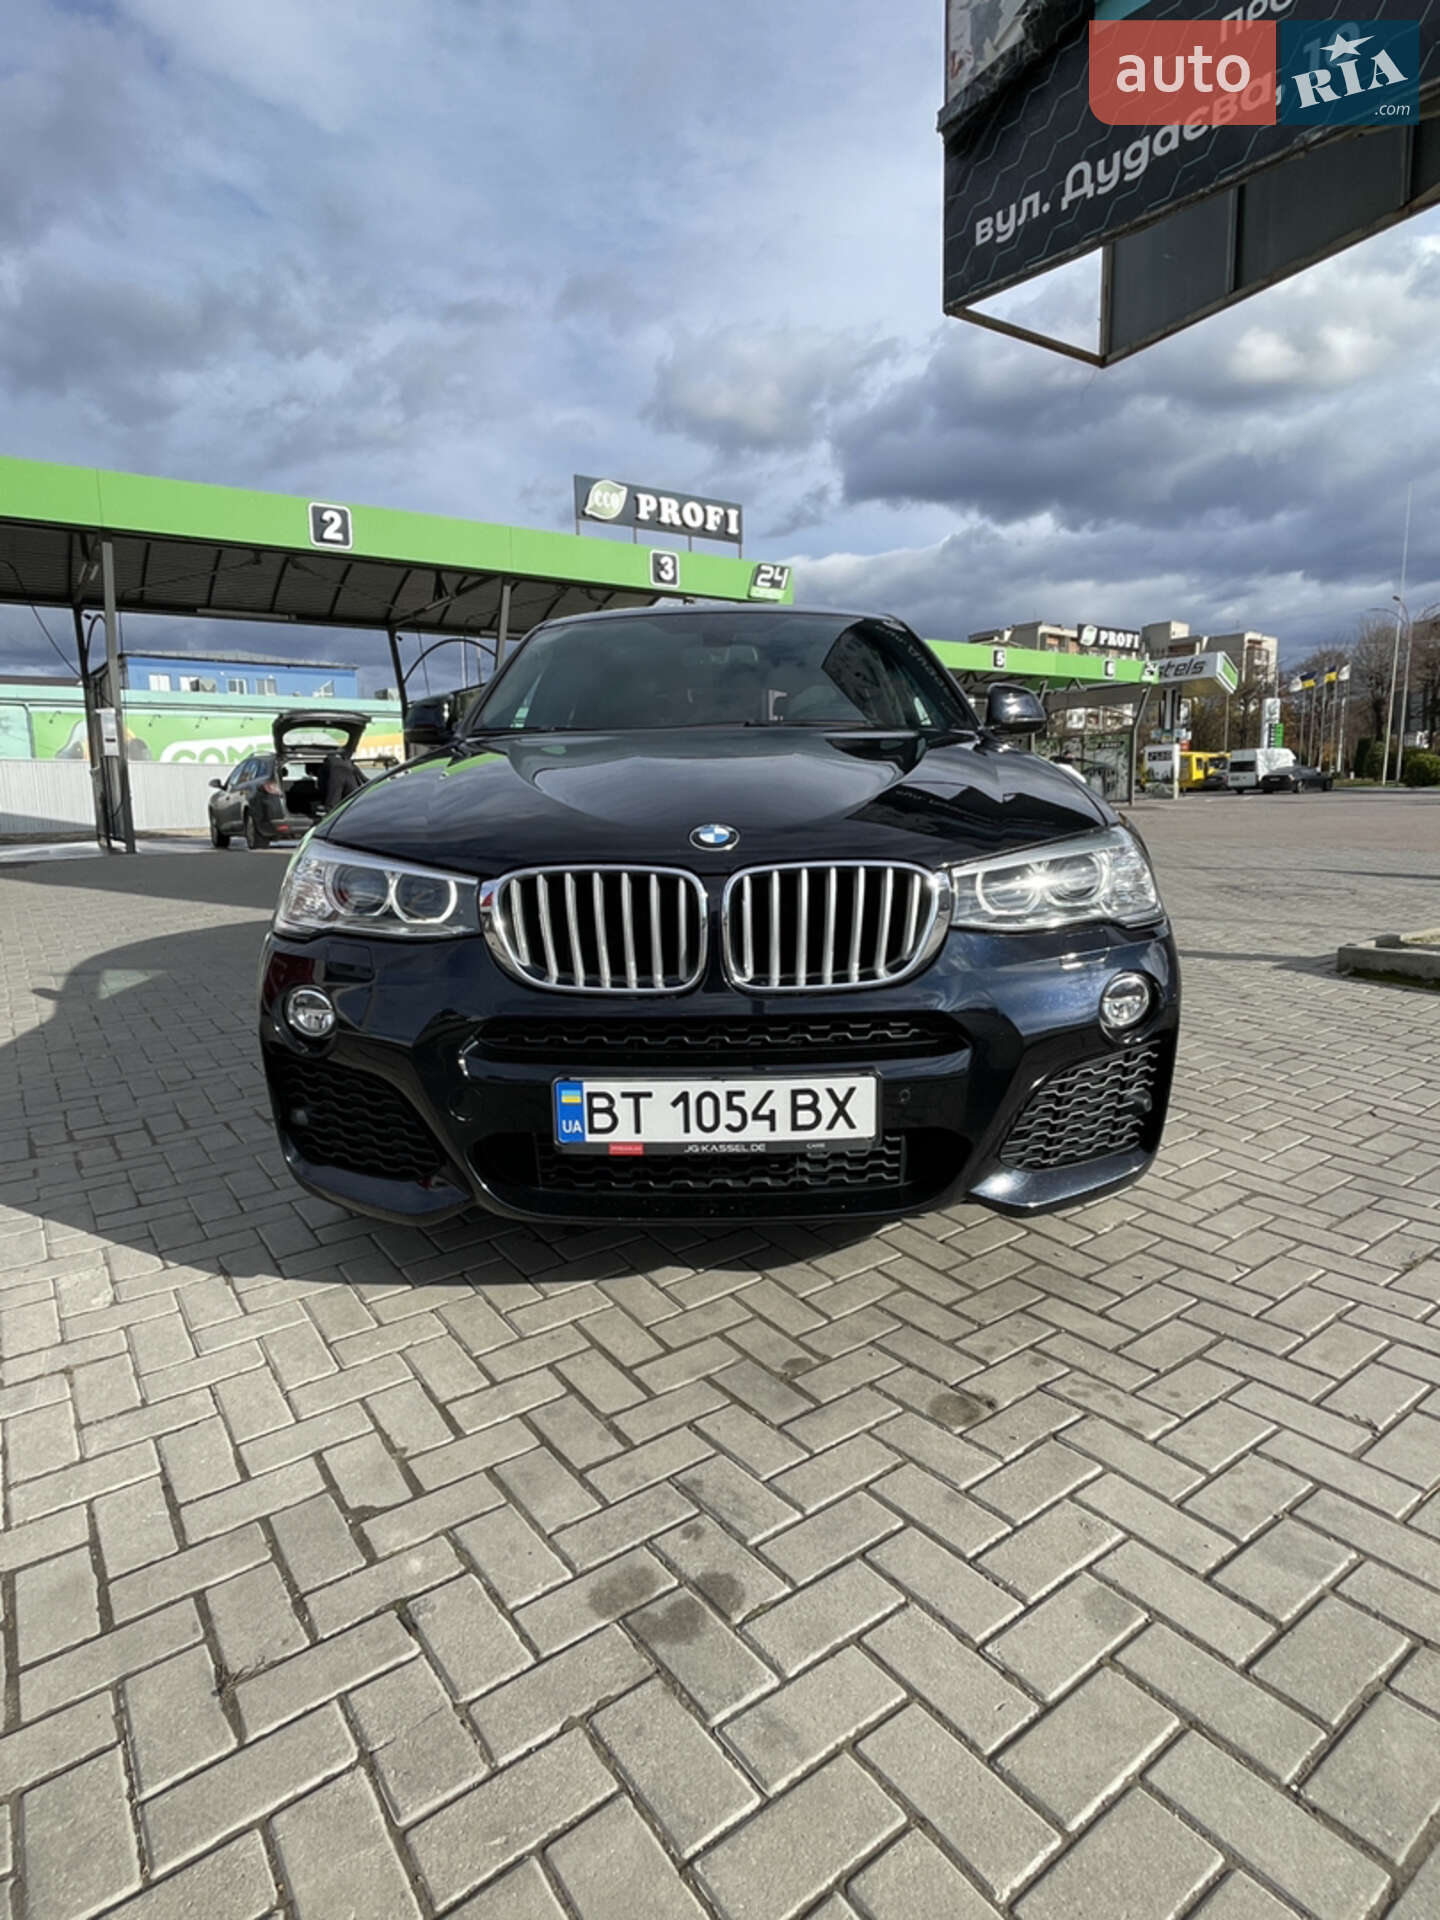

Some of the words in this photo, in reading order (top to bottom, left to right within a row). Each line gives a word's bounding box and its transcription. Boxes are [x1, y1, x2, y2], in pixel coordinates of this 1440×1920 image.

[975, 190, 1051, 247] вул.
[321, 510, 344, 541] 2
[635, 493, 740, 535] PROFI
[659, 556, 675, 581] 3
[756, 565, 789, 589] 24
[1099, 630, 1140, 649] PROFI
[586, 1091, 653, 1135] BT
[670, 1090, 776, 1134] 1054
[790, 1087, 857, 1131] BX
[562, 1120, 583, 1134] UA
